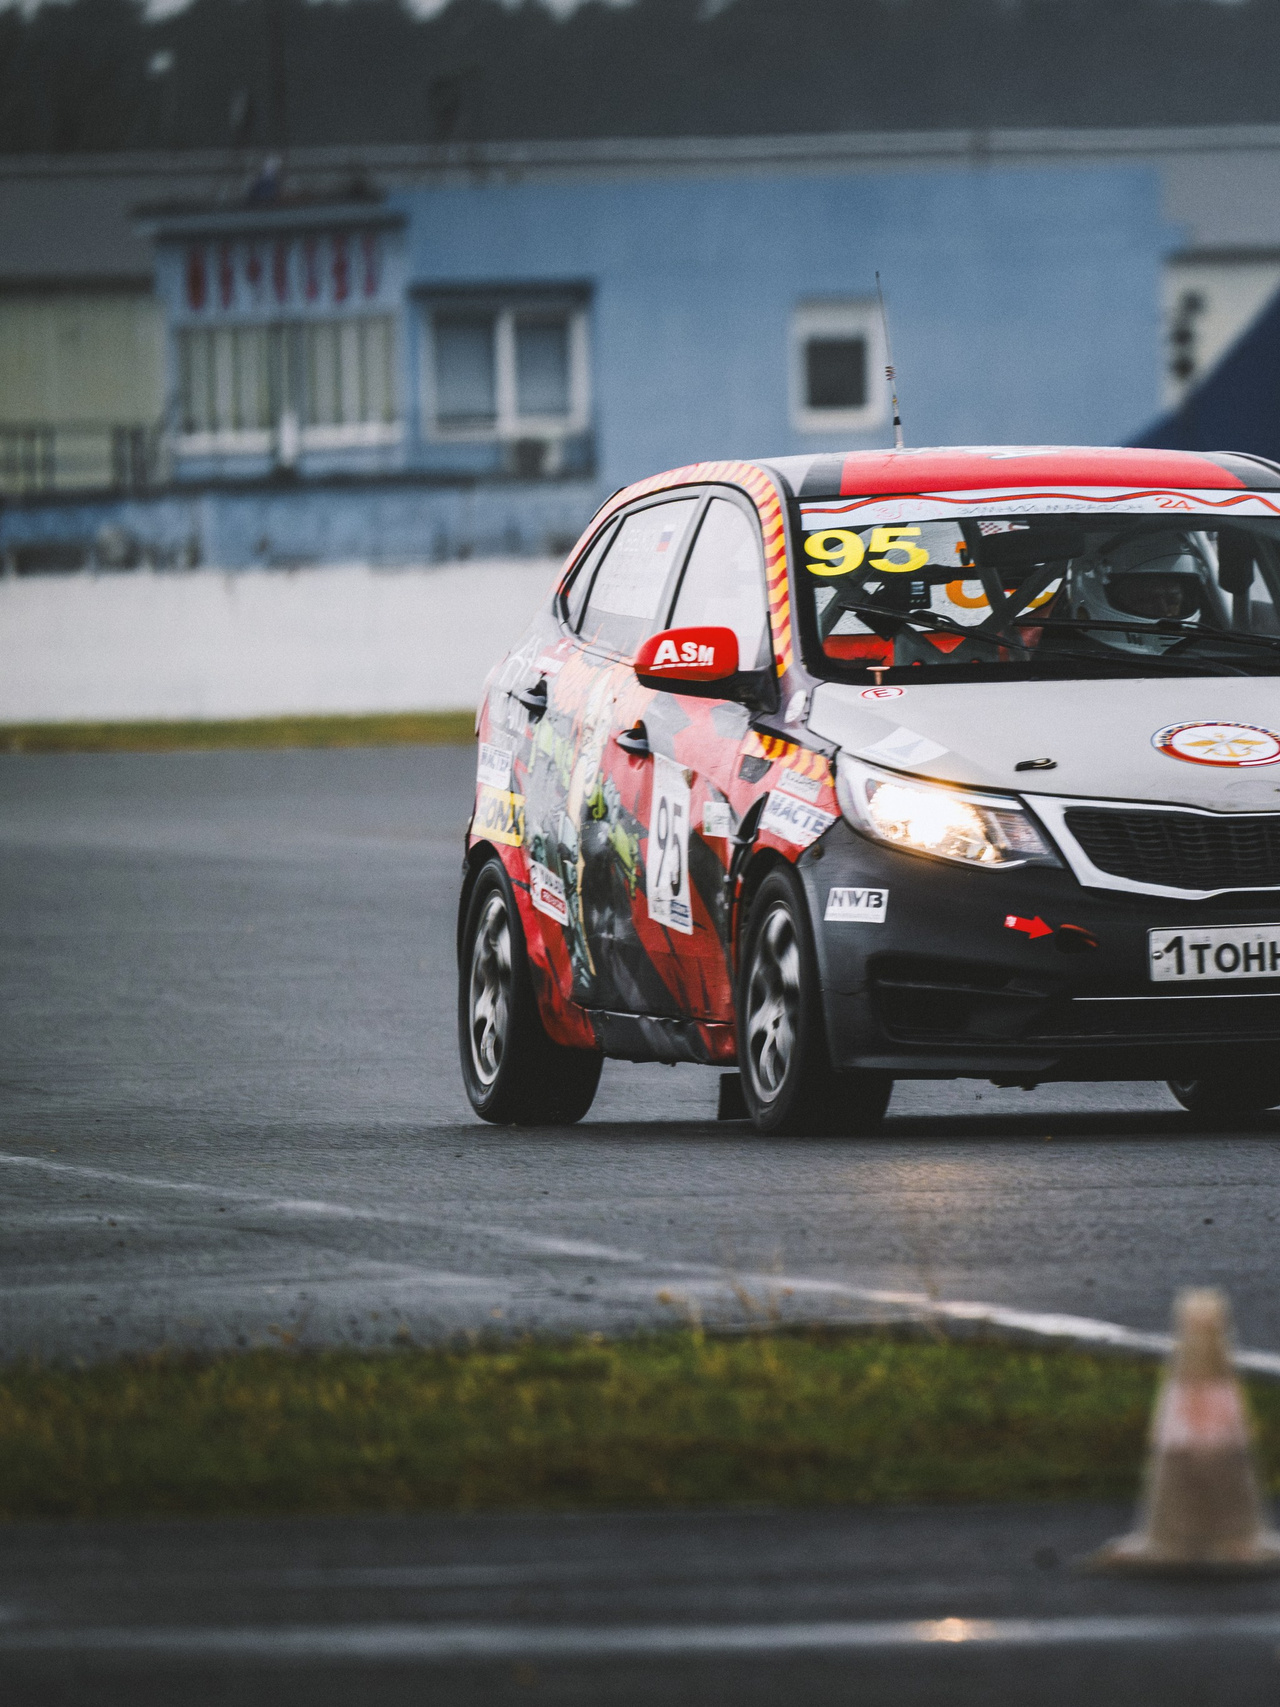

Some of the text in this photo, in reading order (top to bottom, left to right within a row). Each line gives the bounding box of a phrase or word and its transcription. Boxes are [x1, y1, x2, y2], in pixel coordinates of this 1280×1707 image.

[1154, 497, 1197, 511] 24
[804, 527, 930, 576] 95
[655, 795, 682, 897] 95
